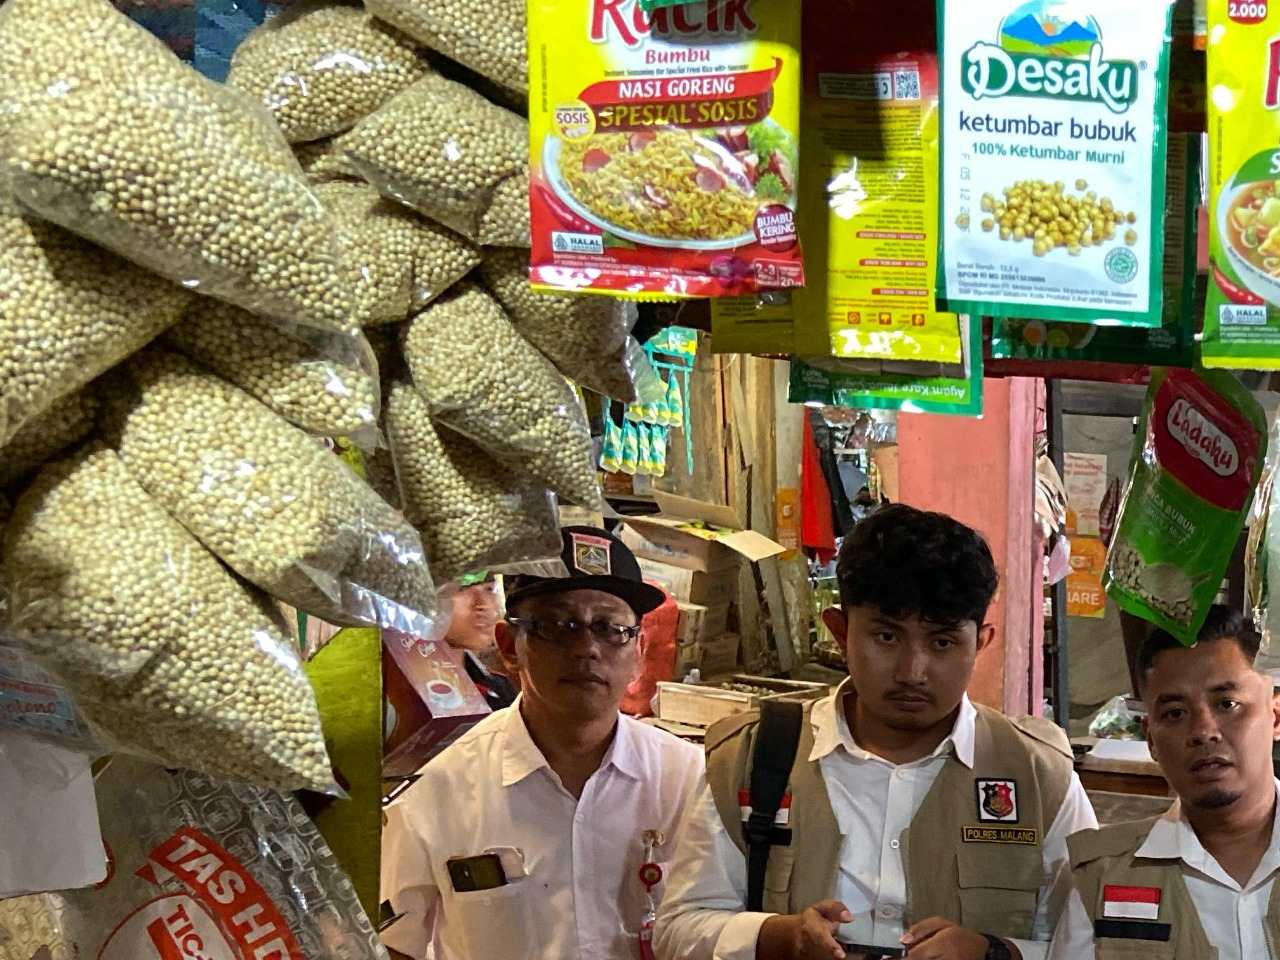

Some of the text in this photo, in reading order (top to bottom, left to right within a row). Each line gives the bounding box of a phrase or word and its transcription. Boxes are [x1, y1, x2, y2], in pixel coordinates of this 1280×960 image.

[1229, 5, 1267, 18] 2.000
[645, 48, 711, 65] Bumbu
[967, 41, 1131, 113] Desaku
[619, 76, 735, 99] NASI GORENG
[556, 112, 590, 125] SOSIS
[600, 99, 758, 127] SPESIAL SOSIS
[959, 110, 1136, 142] ketumbar bubuk
[972, 141, 1125, 165] 100% Ketumbar Murni
[757, 211, 794, 228] BUMBU
[759, 222, 796, 238] KERING
[570, 237, 600, 247] HALAL
[1236, 309, 1265, 318] HALAL
[1172, 402, 1233, 469] Ladaku
[966, 828, 1035, 842] POLRES MALANG
[166, 834, 247, 904] TAS
